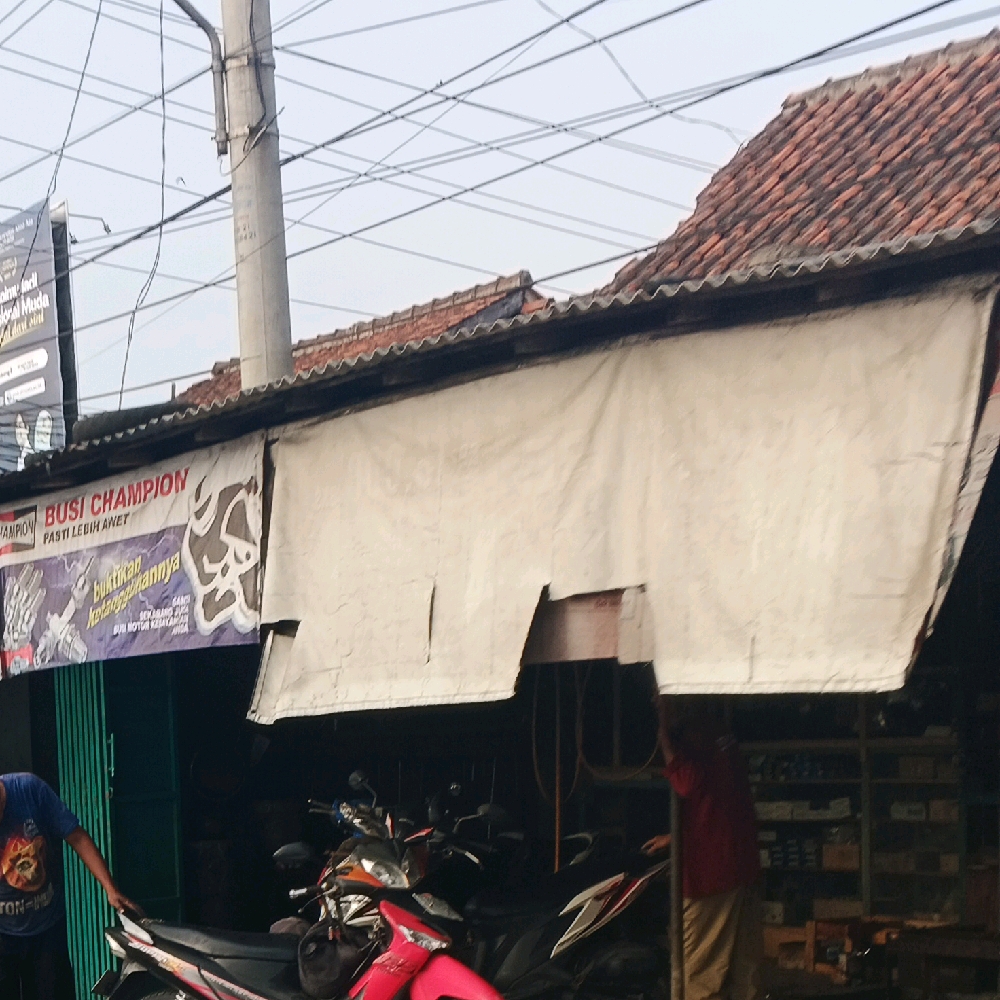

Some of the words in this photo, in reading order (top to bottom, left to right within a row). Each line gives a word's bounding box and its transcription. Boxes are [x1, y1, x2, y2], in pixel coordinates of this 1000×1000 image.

[45, 496, 85, 527] BUSI
[90, 467, 190, 516] CHAMPION
[43, 528, 70, 545] PASTI
[72, 521, 100, 538] LEBIH
[101, 512, 130, 532] AWET
[93, 555, 142, 604] buktikan
